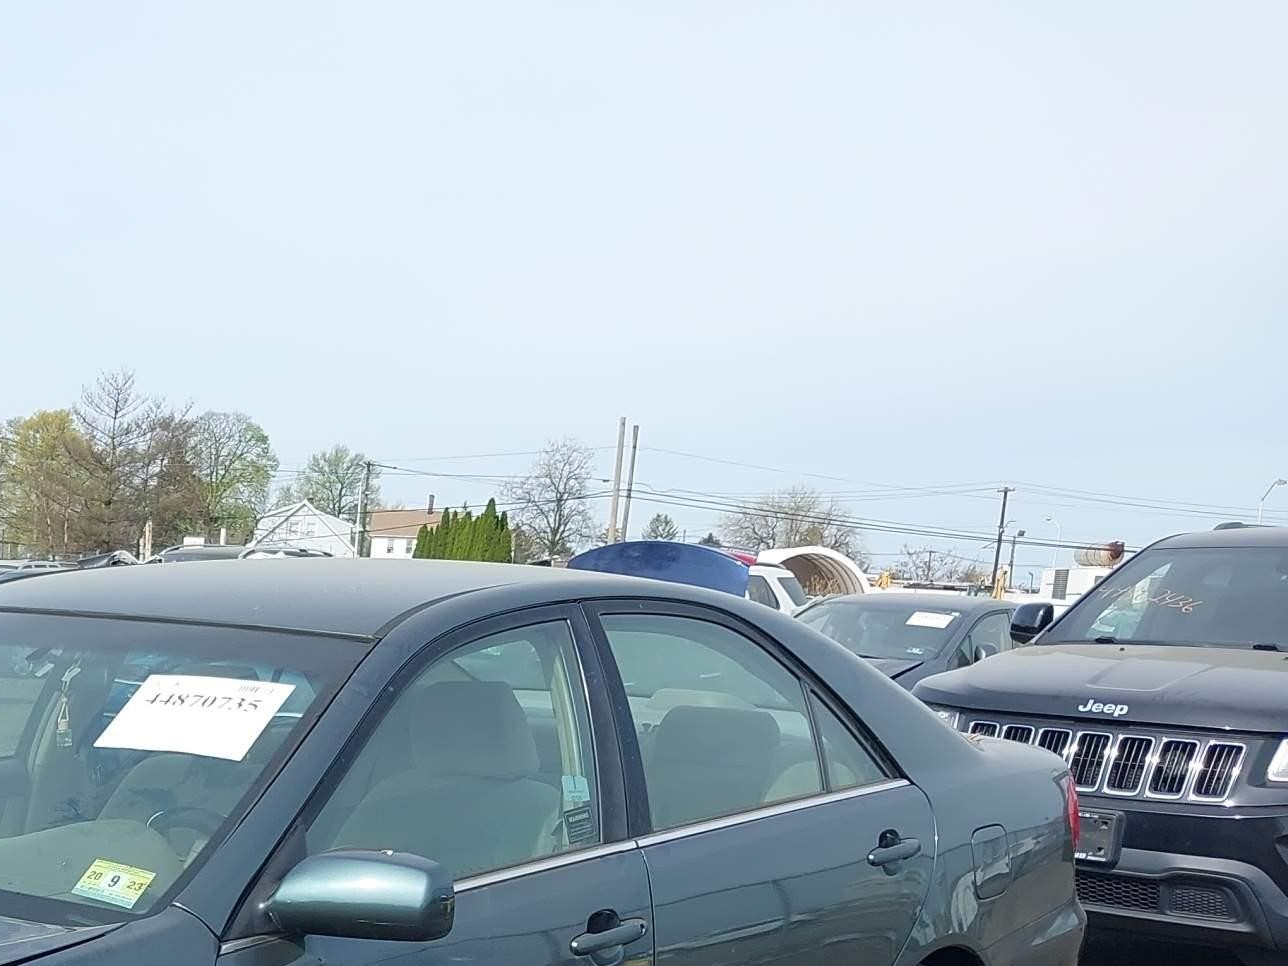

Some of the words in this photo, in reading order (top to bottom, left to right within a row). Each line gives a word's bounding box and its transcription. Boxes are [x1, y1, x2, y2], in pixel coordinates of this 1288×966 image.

[145, 691, 262, 712] 44870735
[1078, 699, 1128, 717] Jeep
[86, 870, 103, 881] 20
[108, 875, 120, 888] 9
[126, 880, 143, 892] 23
